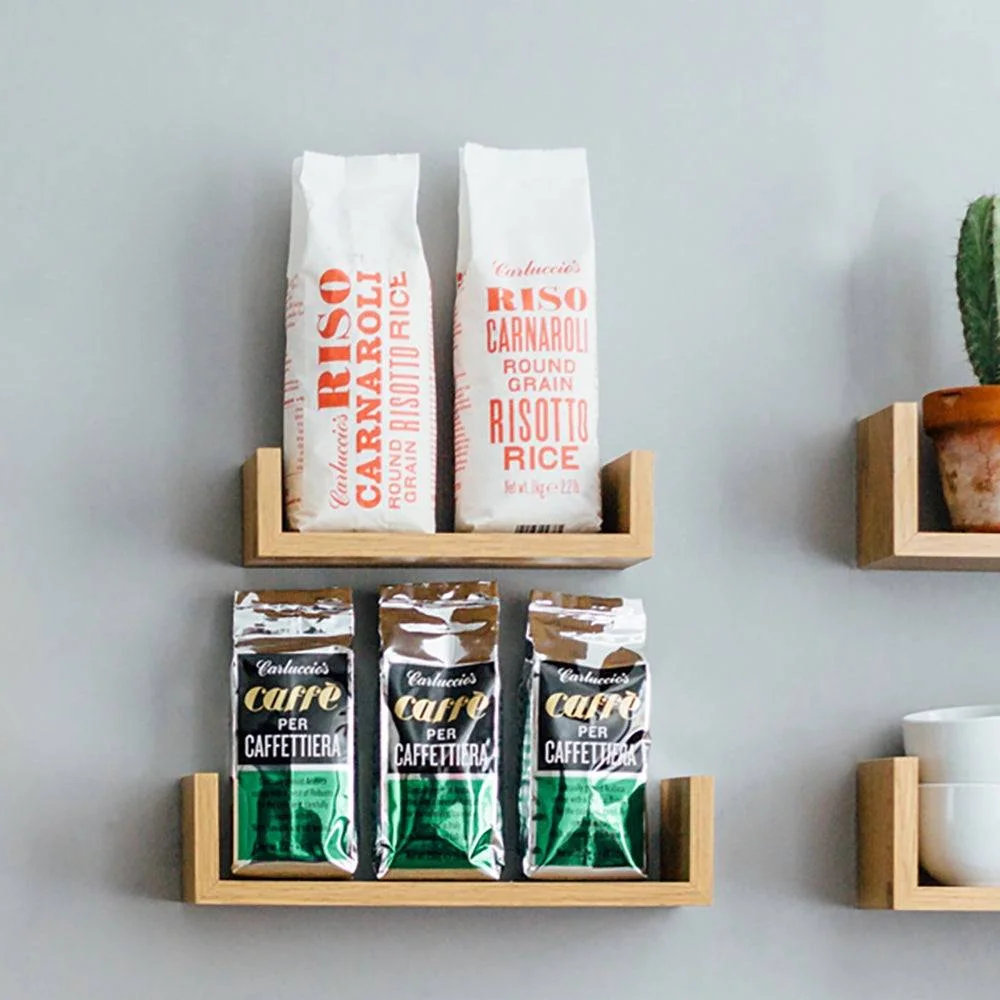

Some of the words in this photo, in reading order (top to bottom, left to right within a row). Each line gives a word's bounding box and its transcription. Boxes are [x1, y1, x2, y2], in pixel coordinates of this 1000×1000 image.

[493, 259, 581, 278] Carluccio's
[389, 271, 409, 340] RICE
[486, 286, 588, 312] RISO
[317, 268, 351, 411] RISO
[486, 316, 588, 353] CARNAROLI
[503, 358, 576, 374] ROUND
[356, 271, 382, 509] CARNAROLI
[389, 346, 420, 432] RISOTTO
[508, 377, 573, 392] GRAIN
[490, 398, 588, 444] RISOTTO
[329, 414, 349, 509] Carluccio's
[503, 446, 580, 470] RICE
[388, 439, 402, 509] ROUND
[404, 441, 416, 503] GRAIN
[256, 659, 330, 677] Carluccio's
[406, 669, 477, 688] Carluccio's
[558, 667, 630, 686] Carluccio's
[244, 682, 342, 713] caffè
[394, 691, 488, 724] caffè
[545, 686, 640, 721] caffè
[278, 718, 308, 731] PER
[426, 728, 457, 741] PER
[578, 725, 608, 739] PER
[245, 734, 341, 758] CAFFETTIERA
[394, 742, 489, 767] CAFFETTIERA
[545, 740, 637, 766] CAFFETTIERA
